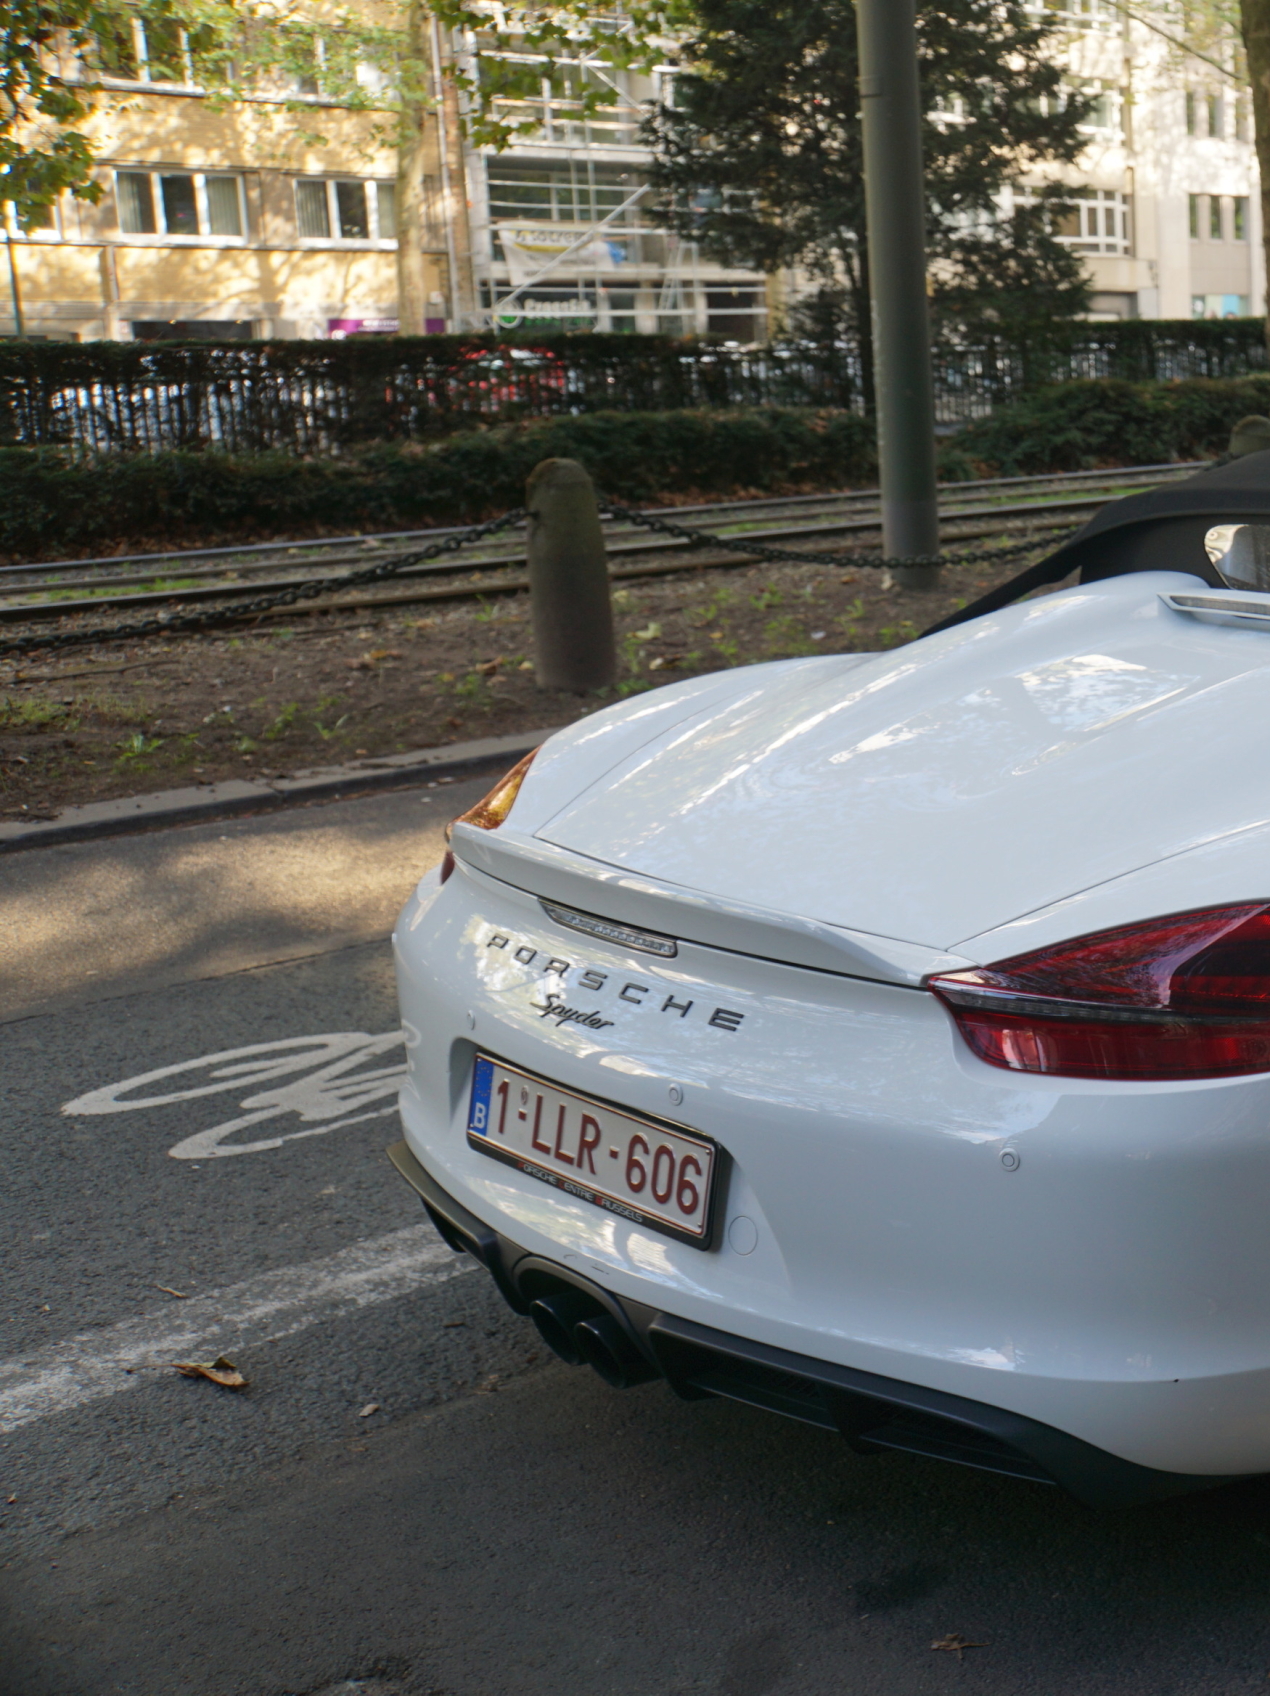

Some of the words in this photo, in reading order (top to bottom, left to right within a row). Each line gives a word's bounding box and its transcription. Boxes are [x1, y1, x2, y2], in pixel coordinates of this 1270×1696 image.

[487, 933, 744, 1031] PORSCHE
[530, 993, 614, 1030] Spyder
[473, 1102, 487, 1129] B
[497, 1078, 702, 1215] 1-LLR-606
[518, 1160, 558, 1185] PORSCHE
[558, 1179, 594, 1201] CENTRE
[595, 1195, 644, 1223] BRUSSELS
